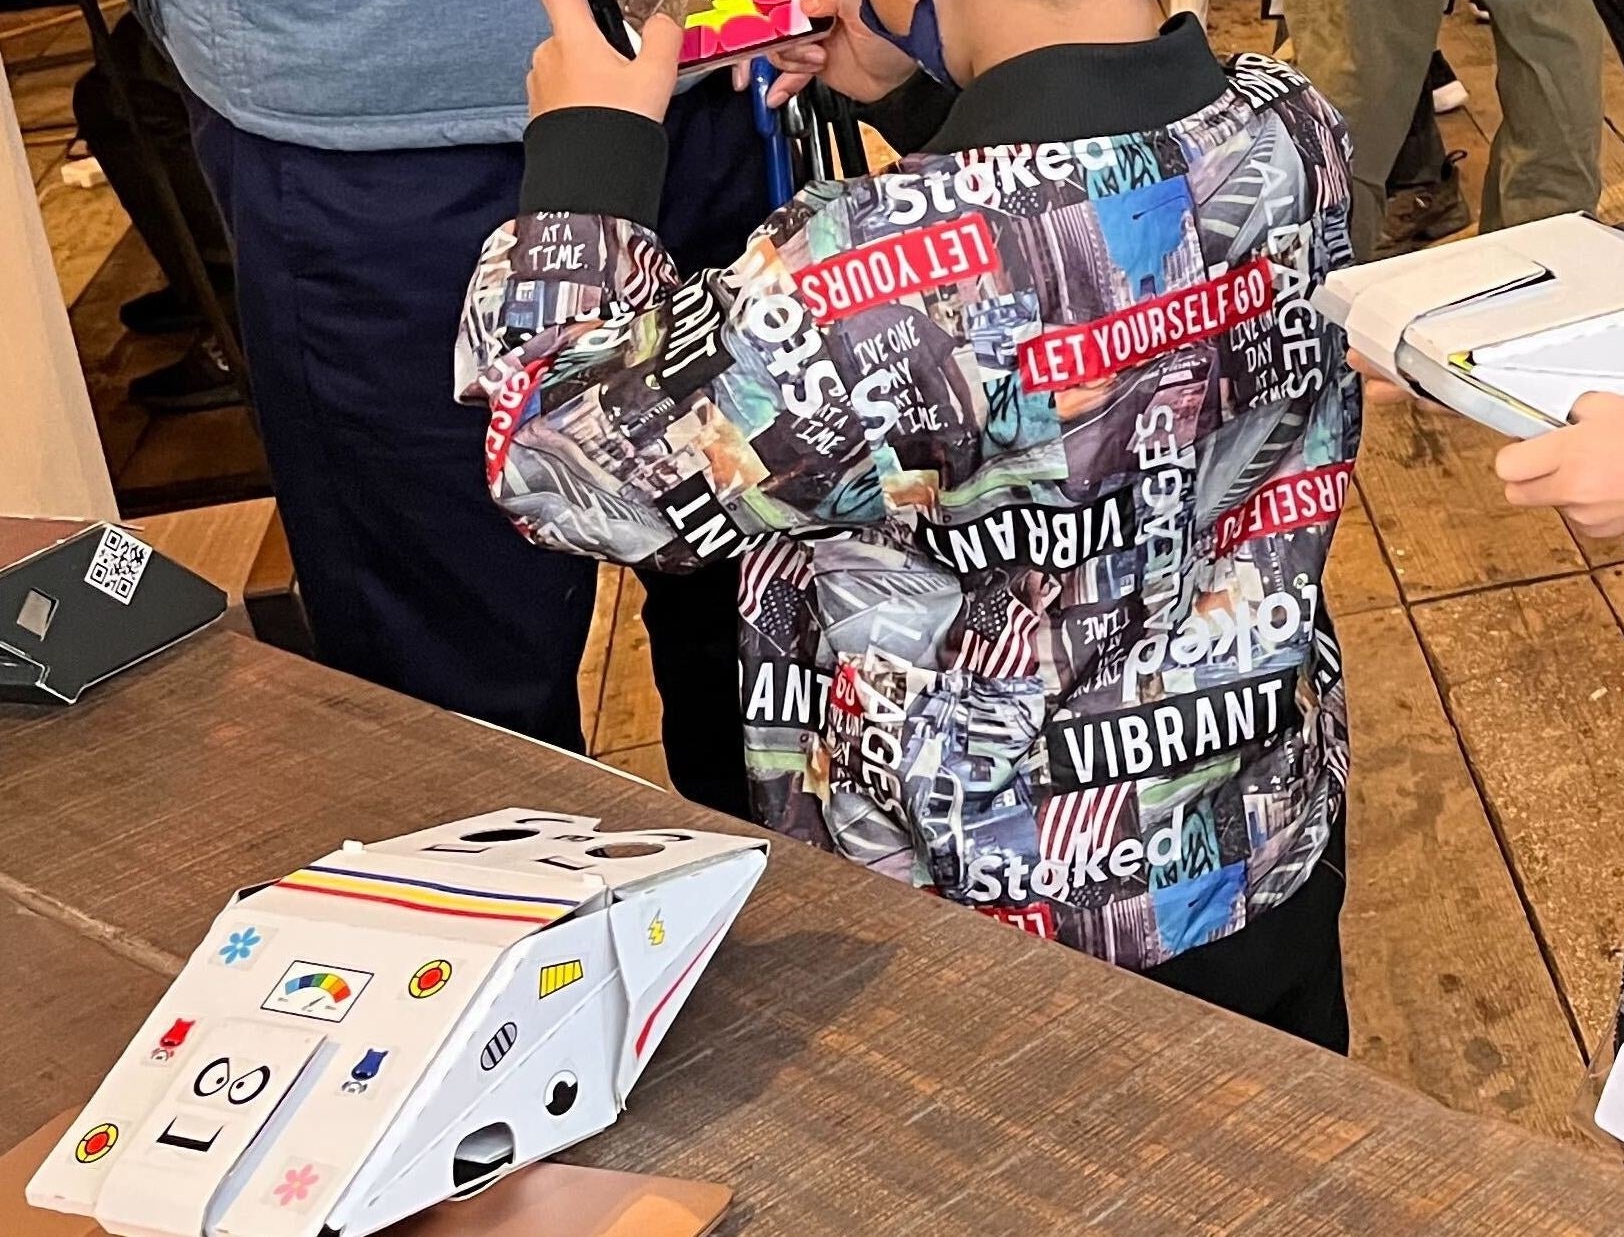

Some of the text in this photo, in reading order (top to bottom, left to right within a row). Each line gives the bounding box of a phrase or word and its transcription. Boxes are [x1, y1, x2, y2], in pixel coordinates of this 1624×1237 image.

[528, 243, 589, 272] TIME.
[541, 224, 560, 243] AT
[801, 222, 990, 316] LET YOURS
[887, 315, 921, 355] ONE
[1027, 268, 1267, 387] LET YOURSELF GO
[1246, 336, 1274, 374] DAY
[1273, 263, 1323, 400] AGES
[1063, 678, 1283, 784] VIBRANT
[965, 804, 1184, 905] Stoked
